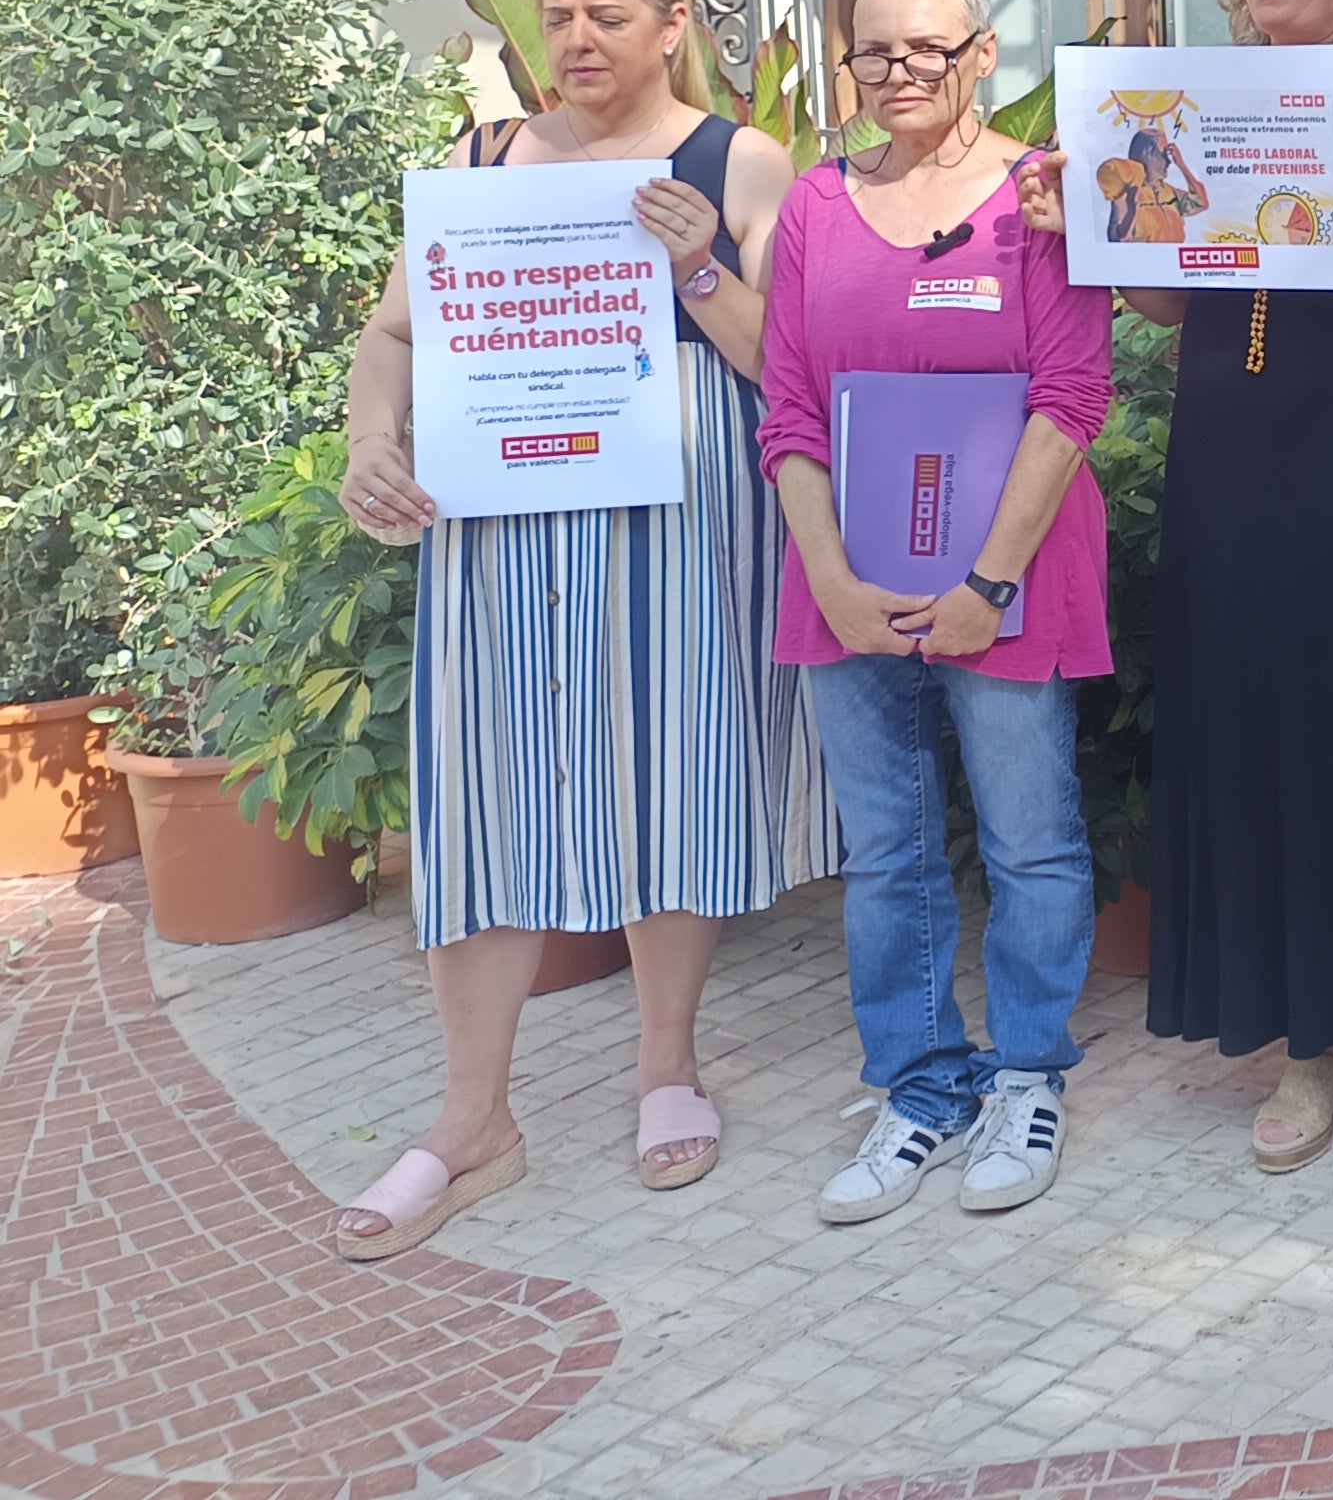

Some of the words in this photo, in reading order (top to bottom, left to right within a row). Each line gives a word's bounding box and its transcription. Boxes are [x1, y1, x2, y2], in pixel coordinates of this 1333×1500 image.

[1280, 95, 1325, 107] CCOO
[1214, 136, 1246, 144] trabajo
[1205, 150, 1216, 158] un
[1220, 148, 1260, 159] RIESGO
[1265, 149, 1318, 159] LABORAL
[1206, 166, 1224, 175] que
[1227, 164, 1249, 174] debe
[1253, 164, 1325, 174] PREVENIRSE
[495, 226, 530, 235] trabajas
[550, 222, 570, 230] altas
[504, 237, 523, 246] muy
[526, 234, 565, 245] peligroso
[1182, 251, 1235, 264] CCOO
[430, 267, 456, 291] Si
[466, 270, 505, 289] no
[514, 260, 652, 290] respetan
[915, 279, 974, 294] CCOO
[441, 302, 474, 321] tu
[483, 288, 647, 323] seguridad,
[450, 321, 642, 352] cuéntanoslo
[469, 373, 496, 381] Habla
[530, 369, 573, 378] delegado
[583, 366, 626, 375] delegada
[506, 438, 569, 455] CCOO
[944, 454, 956, 477] baja
[914, 487, 934, 551] CCOO
